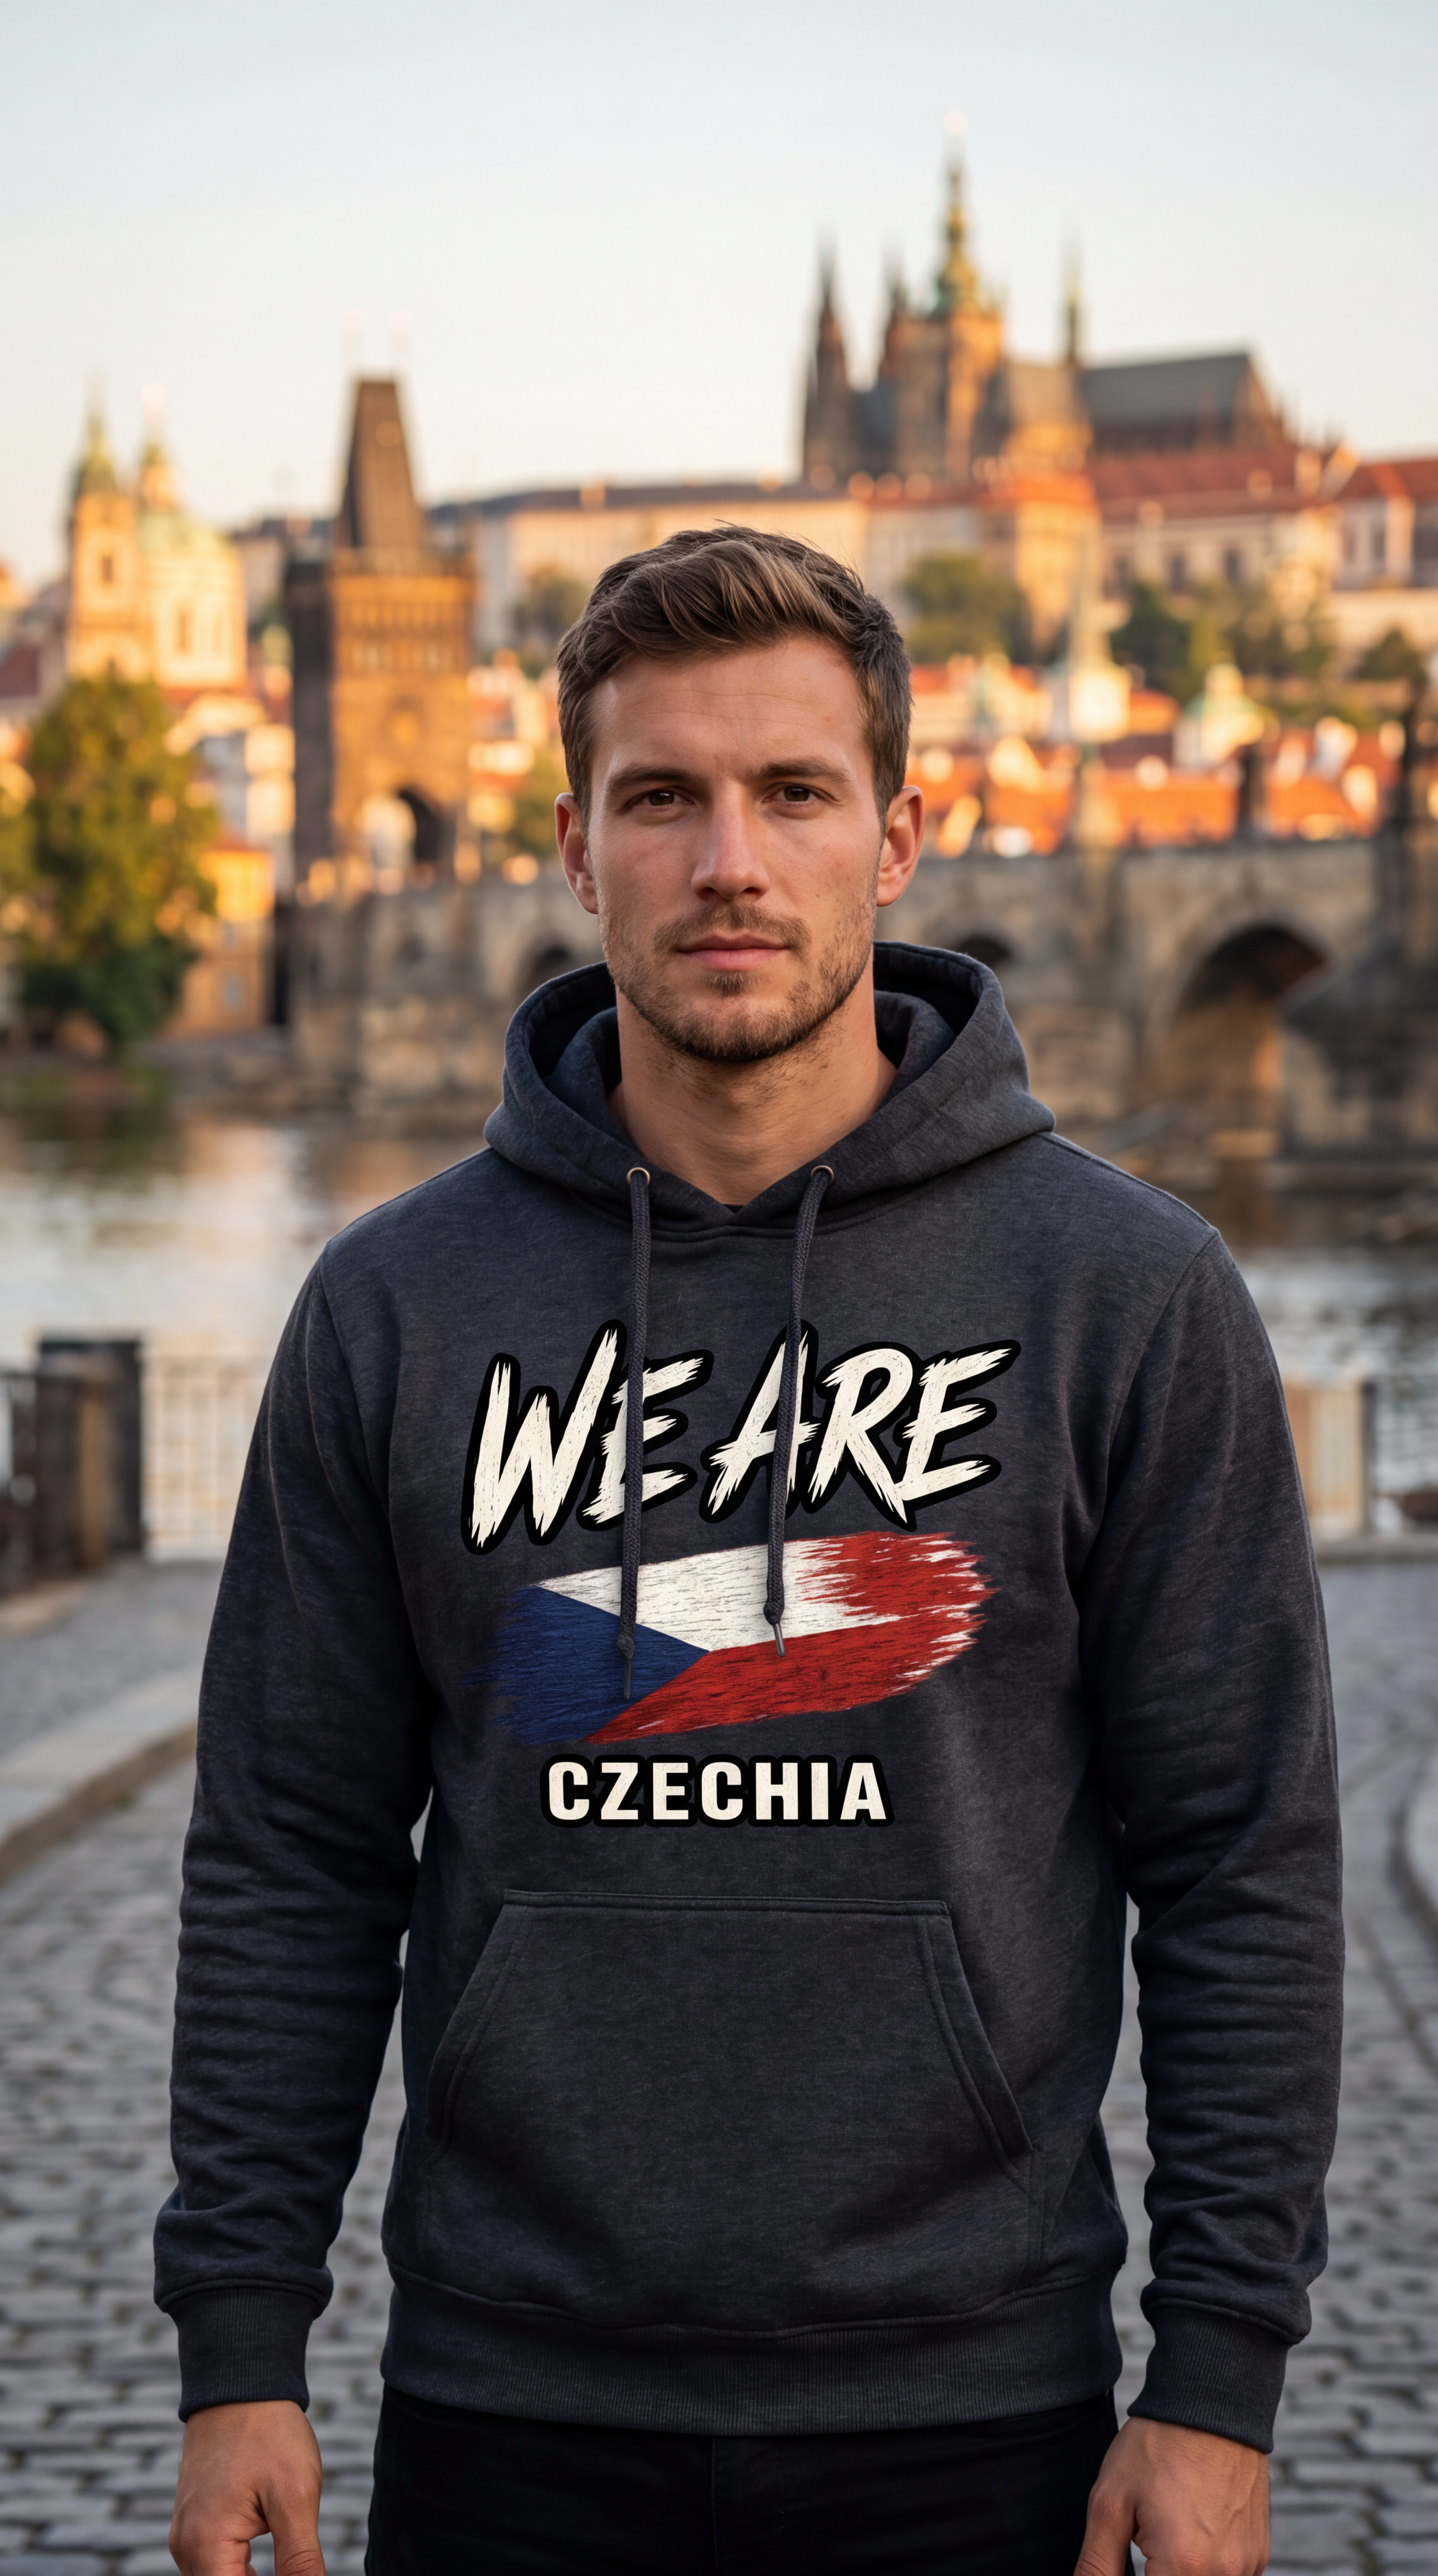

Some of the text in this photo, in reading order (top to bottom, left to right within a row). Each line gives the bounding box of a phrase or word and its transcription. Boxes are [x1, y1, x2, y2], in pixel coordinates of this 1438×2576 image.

[470, 1328, 1012, 1549] WE ARE
[548, 1761, 887, 1821] CZECHIA
